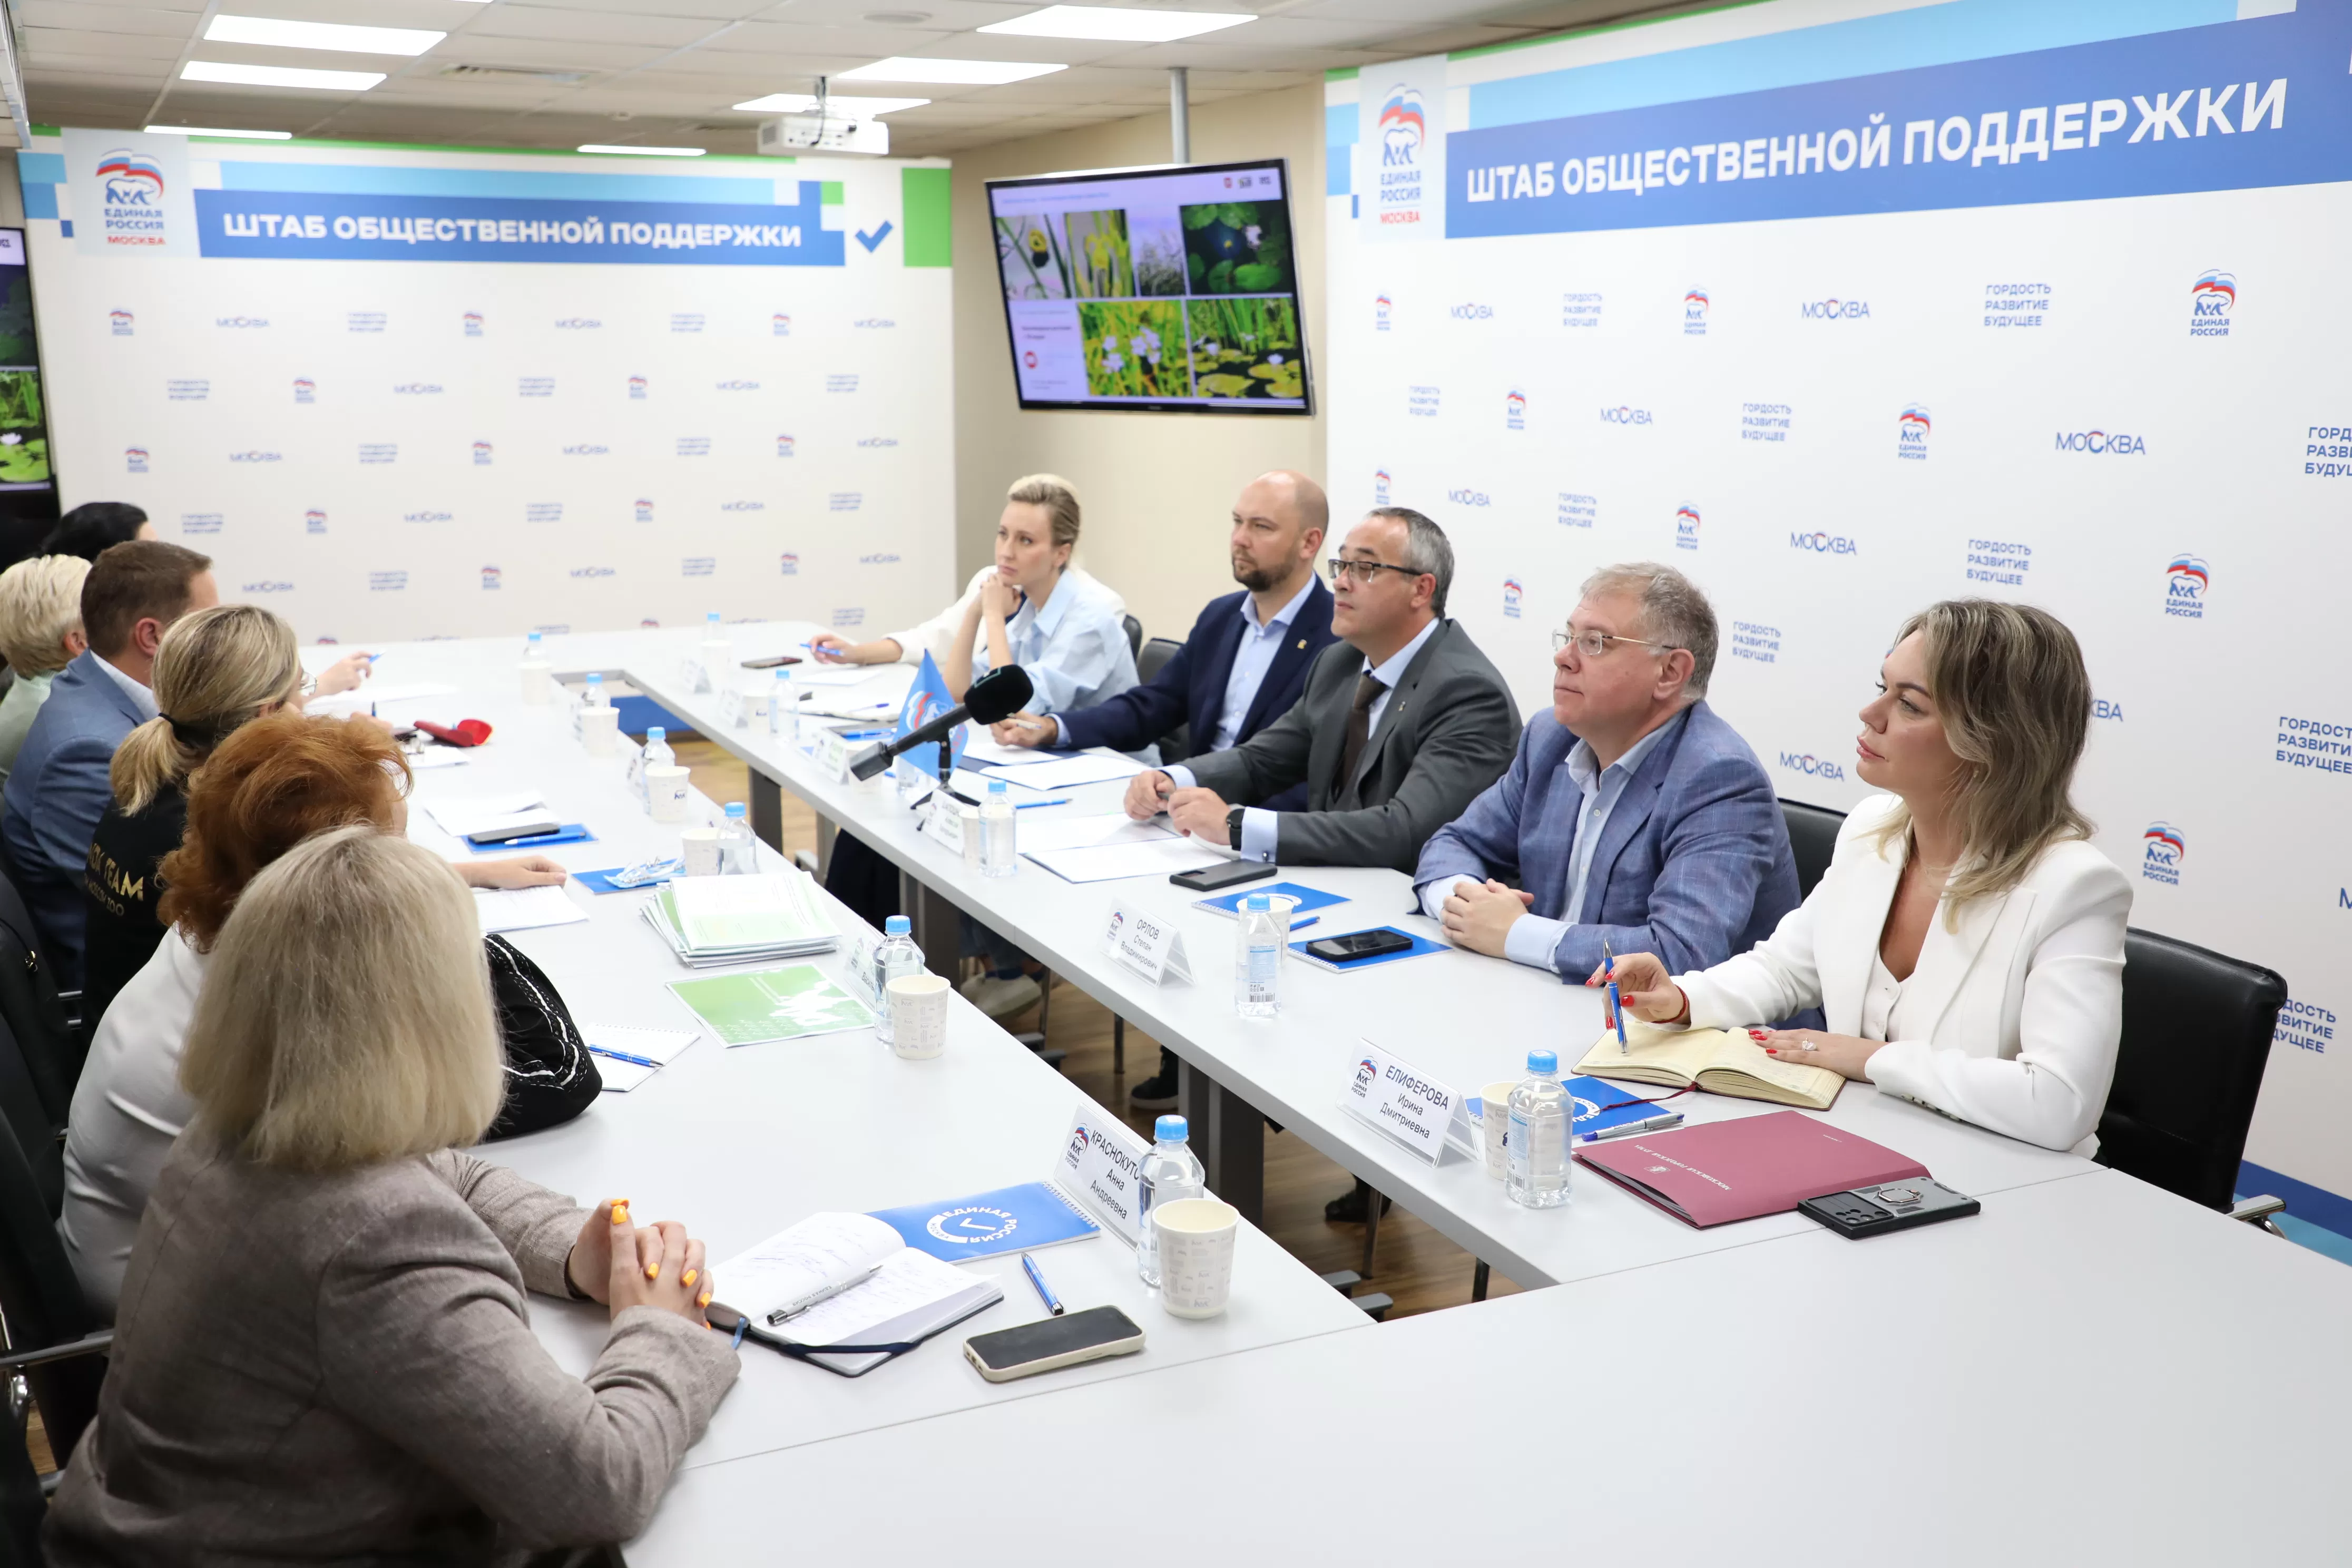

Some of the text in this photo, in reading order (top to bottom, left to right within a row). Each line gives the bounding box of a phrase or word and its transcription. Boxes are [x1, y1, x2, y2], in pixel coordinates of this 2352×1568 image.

[1467, 78, 2287, 203] ШТАБ ОБЩЕСТВЕННОЙ ПОДДЕРЖКИ
[1380, 187, 1421, 202] РОССИЯ
[104, 208, 163, 218] ЕДИНАЯ
[105, 220, 164, 230] РОССИЯ
[223, 213, 801, 249] ШТАБ ОБЩЕСТВЕННОЙ ПОДДЕРЖКИ
[107, 236, 166, 246] МОСКВА
[1986, 283, 2051, 296] ГОРДОСТЬ
[1801, 298, 1870, 320] МОСКВА
[1985, 299, 2049, 311] РАЗВИТИЕ
[1984, 315, 2042, 328] БУДУЩЕЕ
[2190, 318, 2230, 327] ЕДИНАЯ
[2190, 328, 2230, 337] РОССИЯ
[1601, 406, 1652, 425] МОСКВА
[2055, 429, 2146, 456] МОСКВА
[2307, 445, 2352, 458] РАЗВ
[1791, 532, 1857, 555] МОСКВА
[1968, 540, 2032, 556] ГОРДОСТЬ
[1967, 554, 2029, 571] РАЗВИТИЕ
[1966, 569, 2023, 585] БУДУЩЕЕ
[2166, 598, 2203, 609] ЕДИНАЯ
[2165, 607, 2202, 619] РОССИЯ
[1780, 751, 1844, 782] МОСКВА
[2276, 750, 2352, 774] БУДУЩЕЕ
[2143, 862, 2179, 876] ЕДИНАЯ
[104, 857, 144, 901] TEAM
[2142, 870, 2179, 886] РОССИЯ
[106, 896, 125, 916] ZOO
[1136, 919, 1160, 940] ОРЛОВ
[1134, 935, 1152, 952] Степан
[1121, 940, 1158, 971] Владимирович
[1351, 1086, 1366, 1099] РОССИЯ
[1353, 1081, 1368, 1093] ЕДИНАЯ
[1386, 1065, 1449, 1110] ЕЛИФЕРОВА
[1397, 1093, 1424, 1116] Ирина
[1380, 1102, 1430, 1139] Дмитриевна
[1067, 1150, 1080, 1164] ЕДИНАЯ
[1090, 1130, 1139, 1180] КРАСНОКУТС
[1065, 1157, 1077, 1171] РОССИЯ
[1106, 1168, 1125, 1191] Анна
[1090, 1180, 1128, 1220] Андреевна
[942, 1207, 1017, 1243] ЕДИНАЯ РОССИЯ
